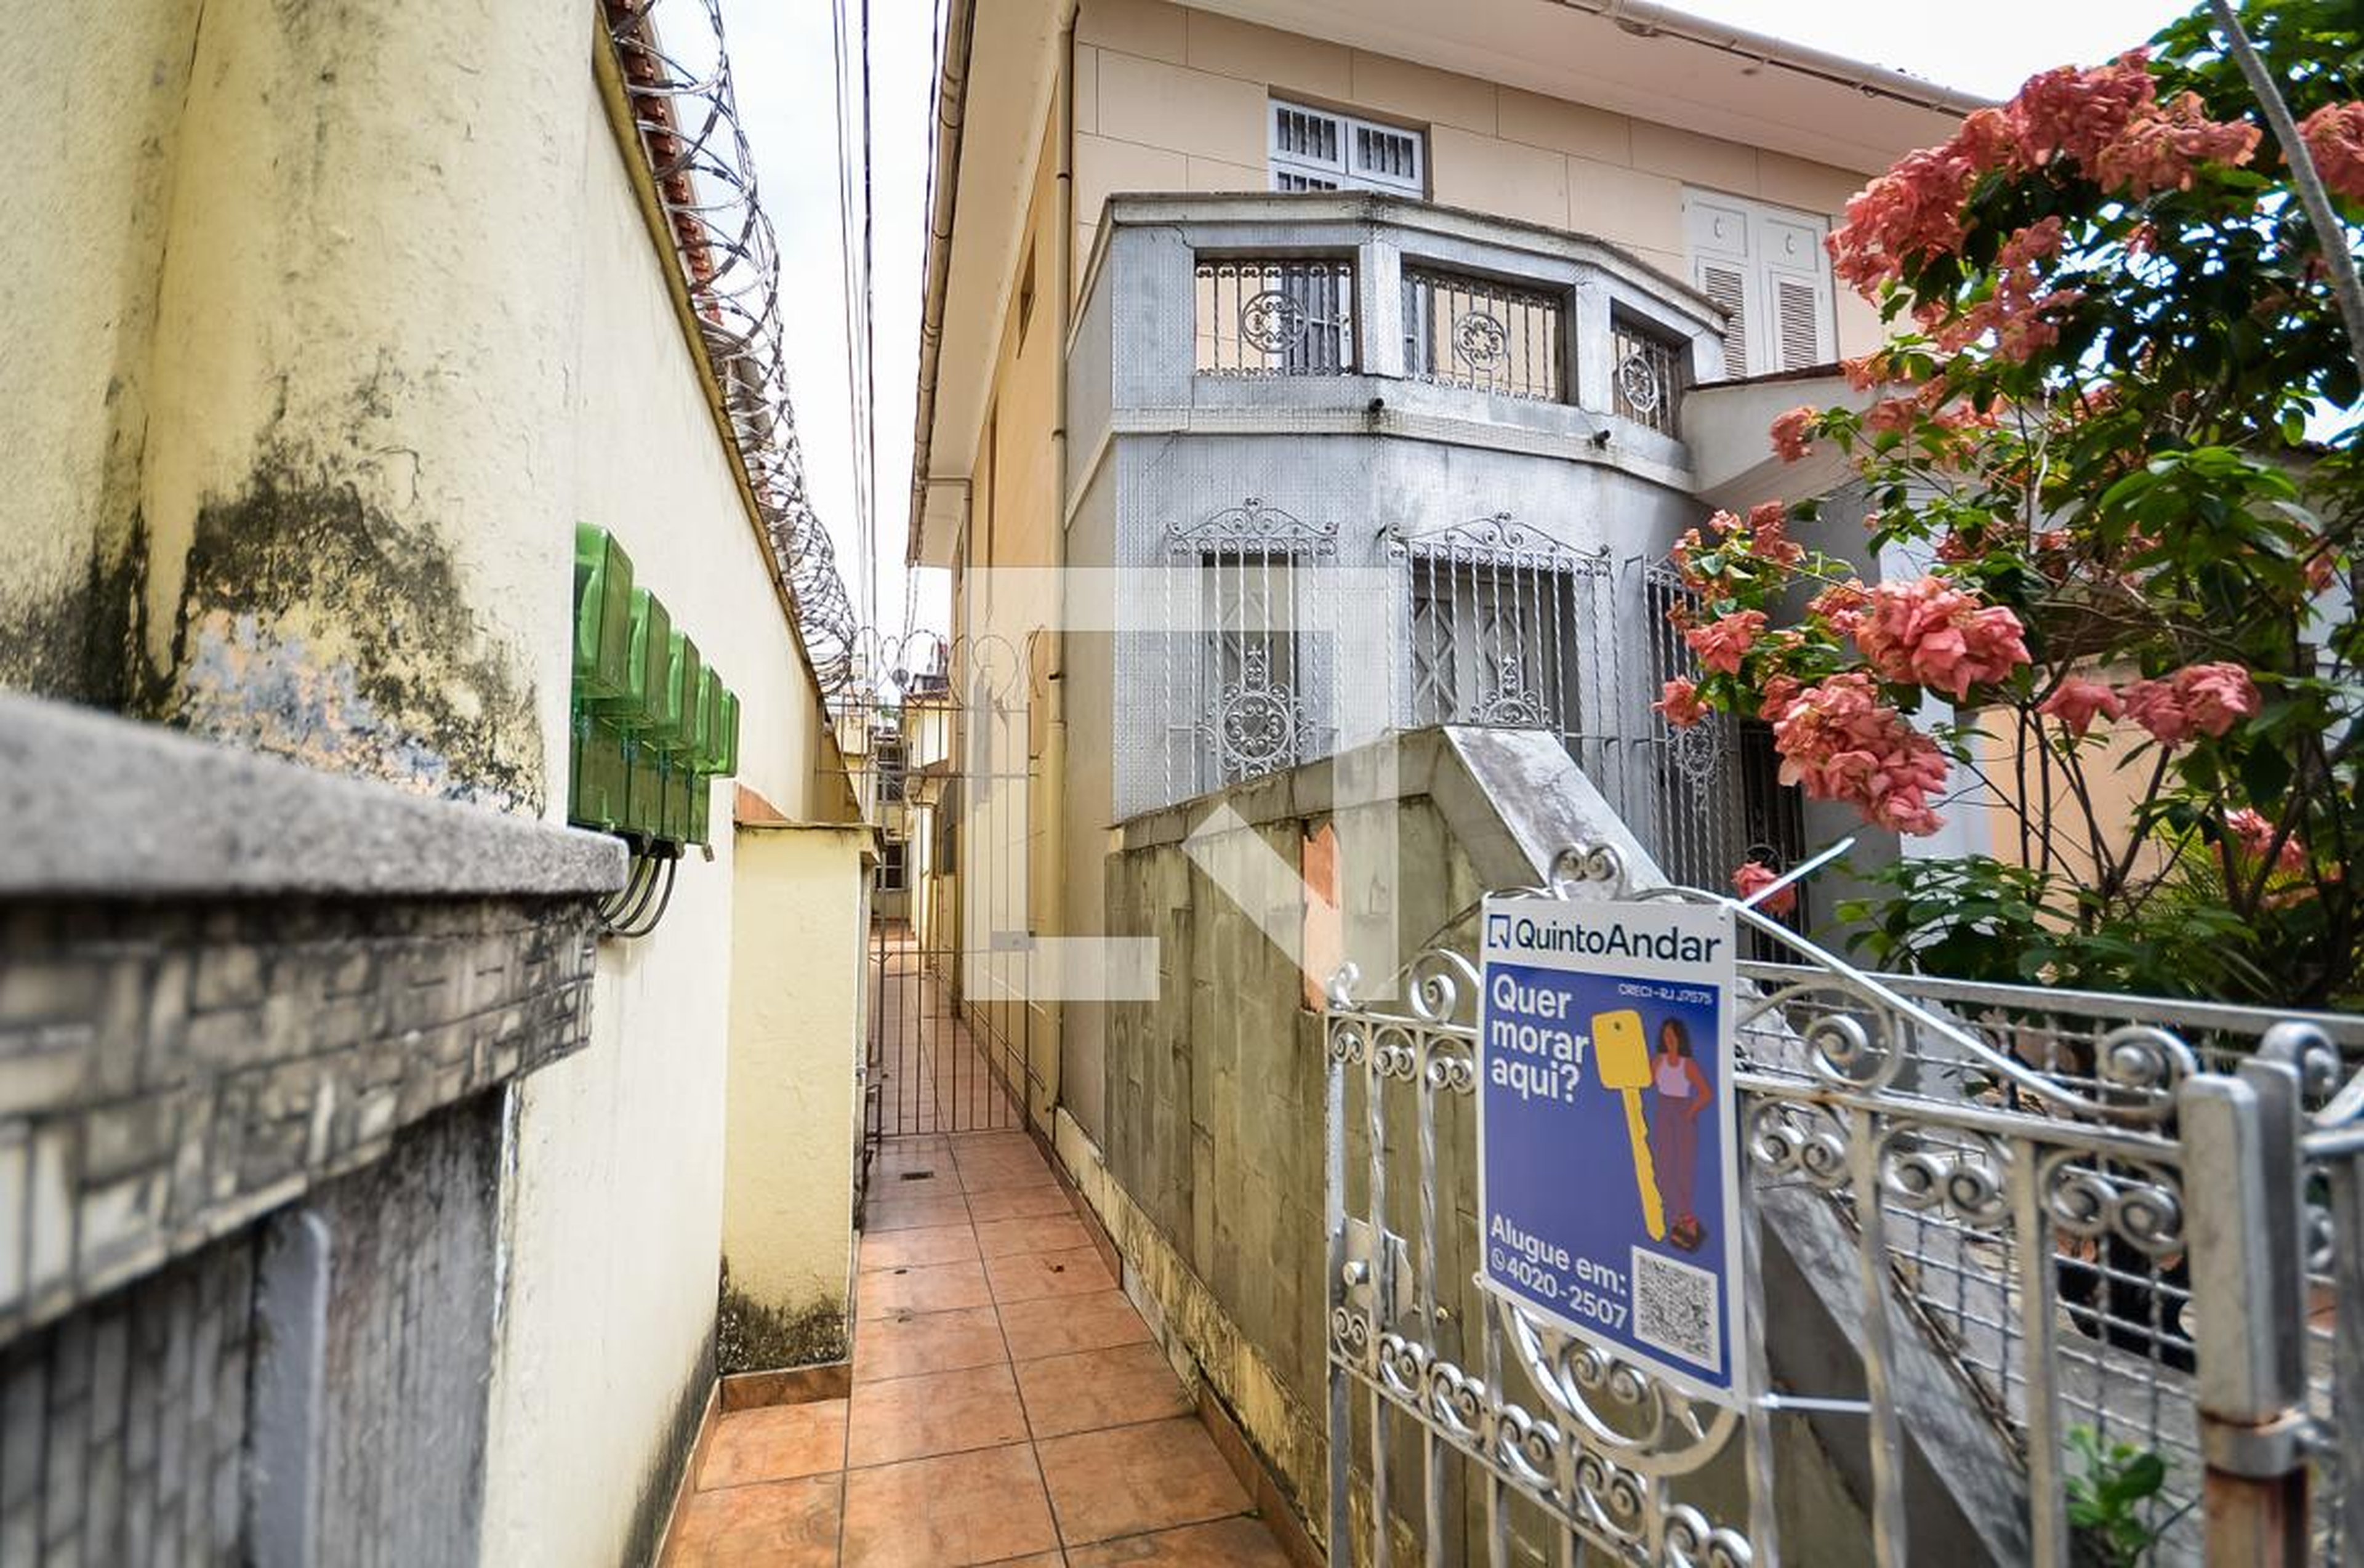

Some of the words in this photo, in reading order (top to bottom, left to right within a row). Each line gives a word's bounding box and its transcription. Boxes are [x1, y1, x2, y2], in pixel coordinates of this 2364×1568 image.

[1516, 919, 1721, 963] QuintoAndar
[1493, 973, 1572, 1019] Quer
[1492, 1019, 1590, 1063] morar
[1492, 1059, 1580, 1103] aqui?
[1490, 1213, 1570, 1271] Alugue
[1575, 1256, 1626, 1296] em:
